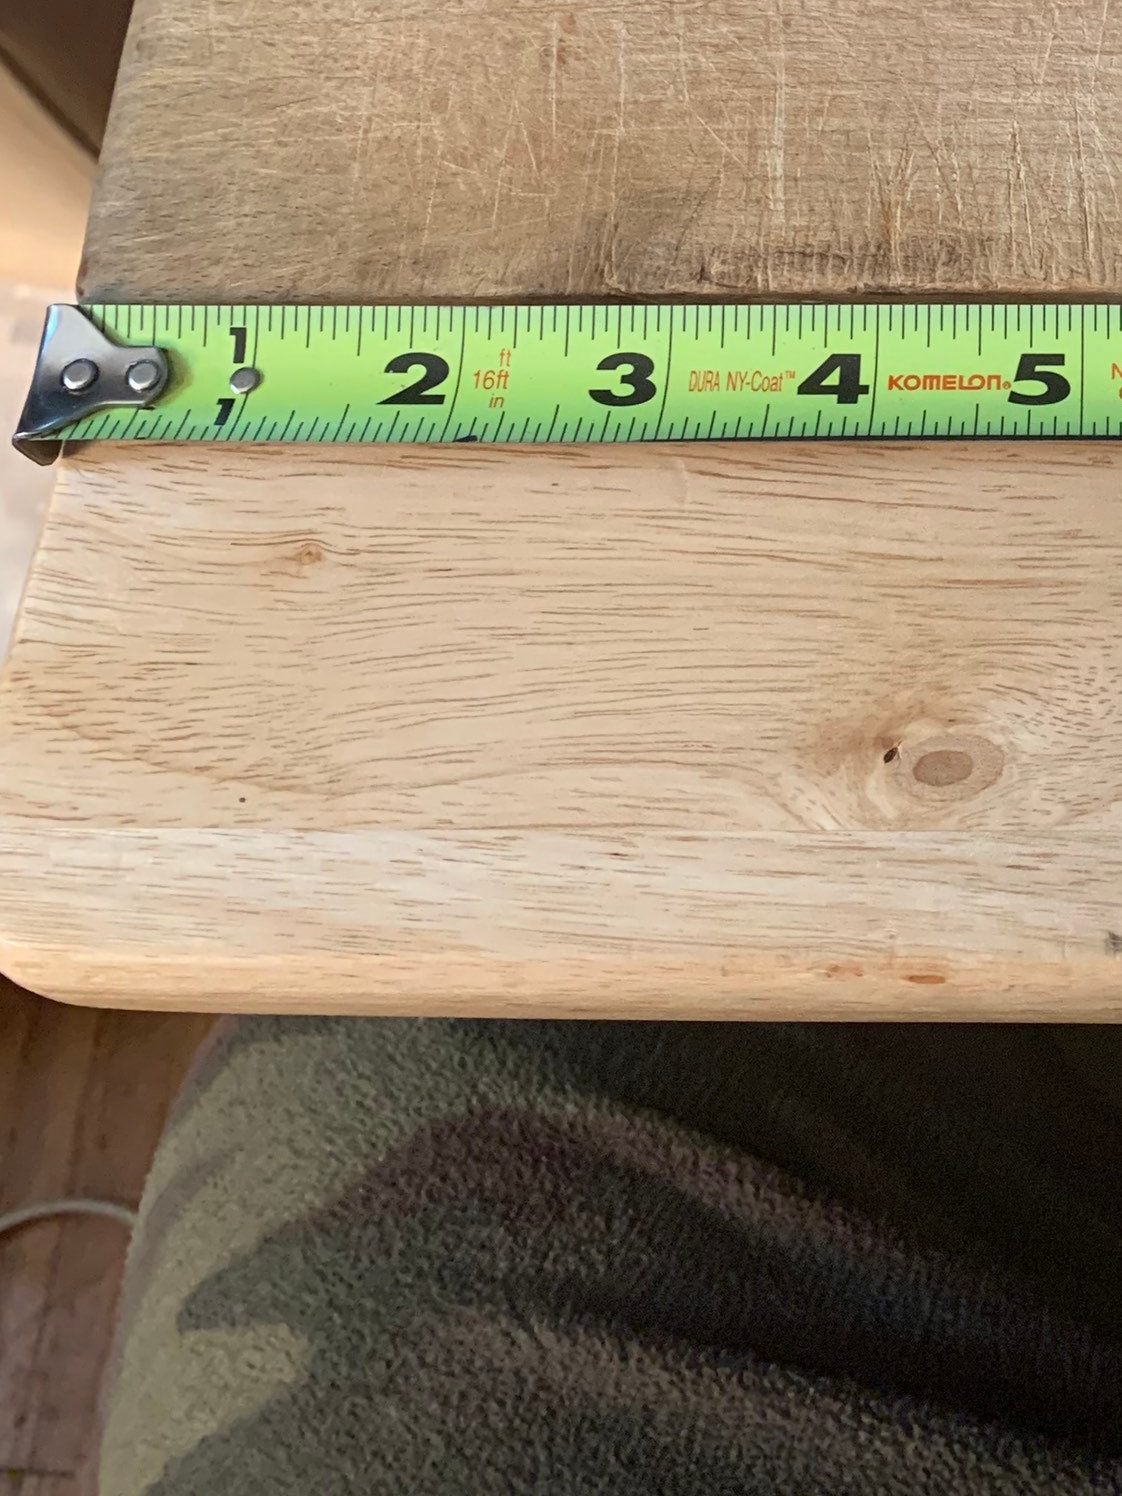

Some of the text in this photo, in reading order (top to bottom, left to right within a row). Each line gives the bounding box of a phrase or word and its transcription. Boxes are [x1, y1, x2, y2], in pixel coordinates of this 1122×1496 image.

[230, 327, 247, 364] 1
[376, 352, 450, 406] 2
[473, 370, 510, 391] 16ft
[588, 352, 657, 407] 3
[688, 371, 720, 393] DURA
[797, 353, 870, 405] 4
[1007, 353, 1071, 406] 5
[213, 398, 237, 426] 1
[488, 394, 505, 409] in
